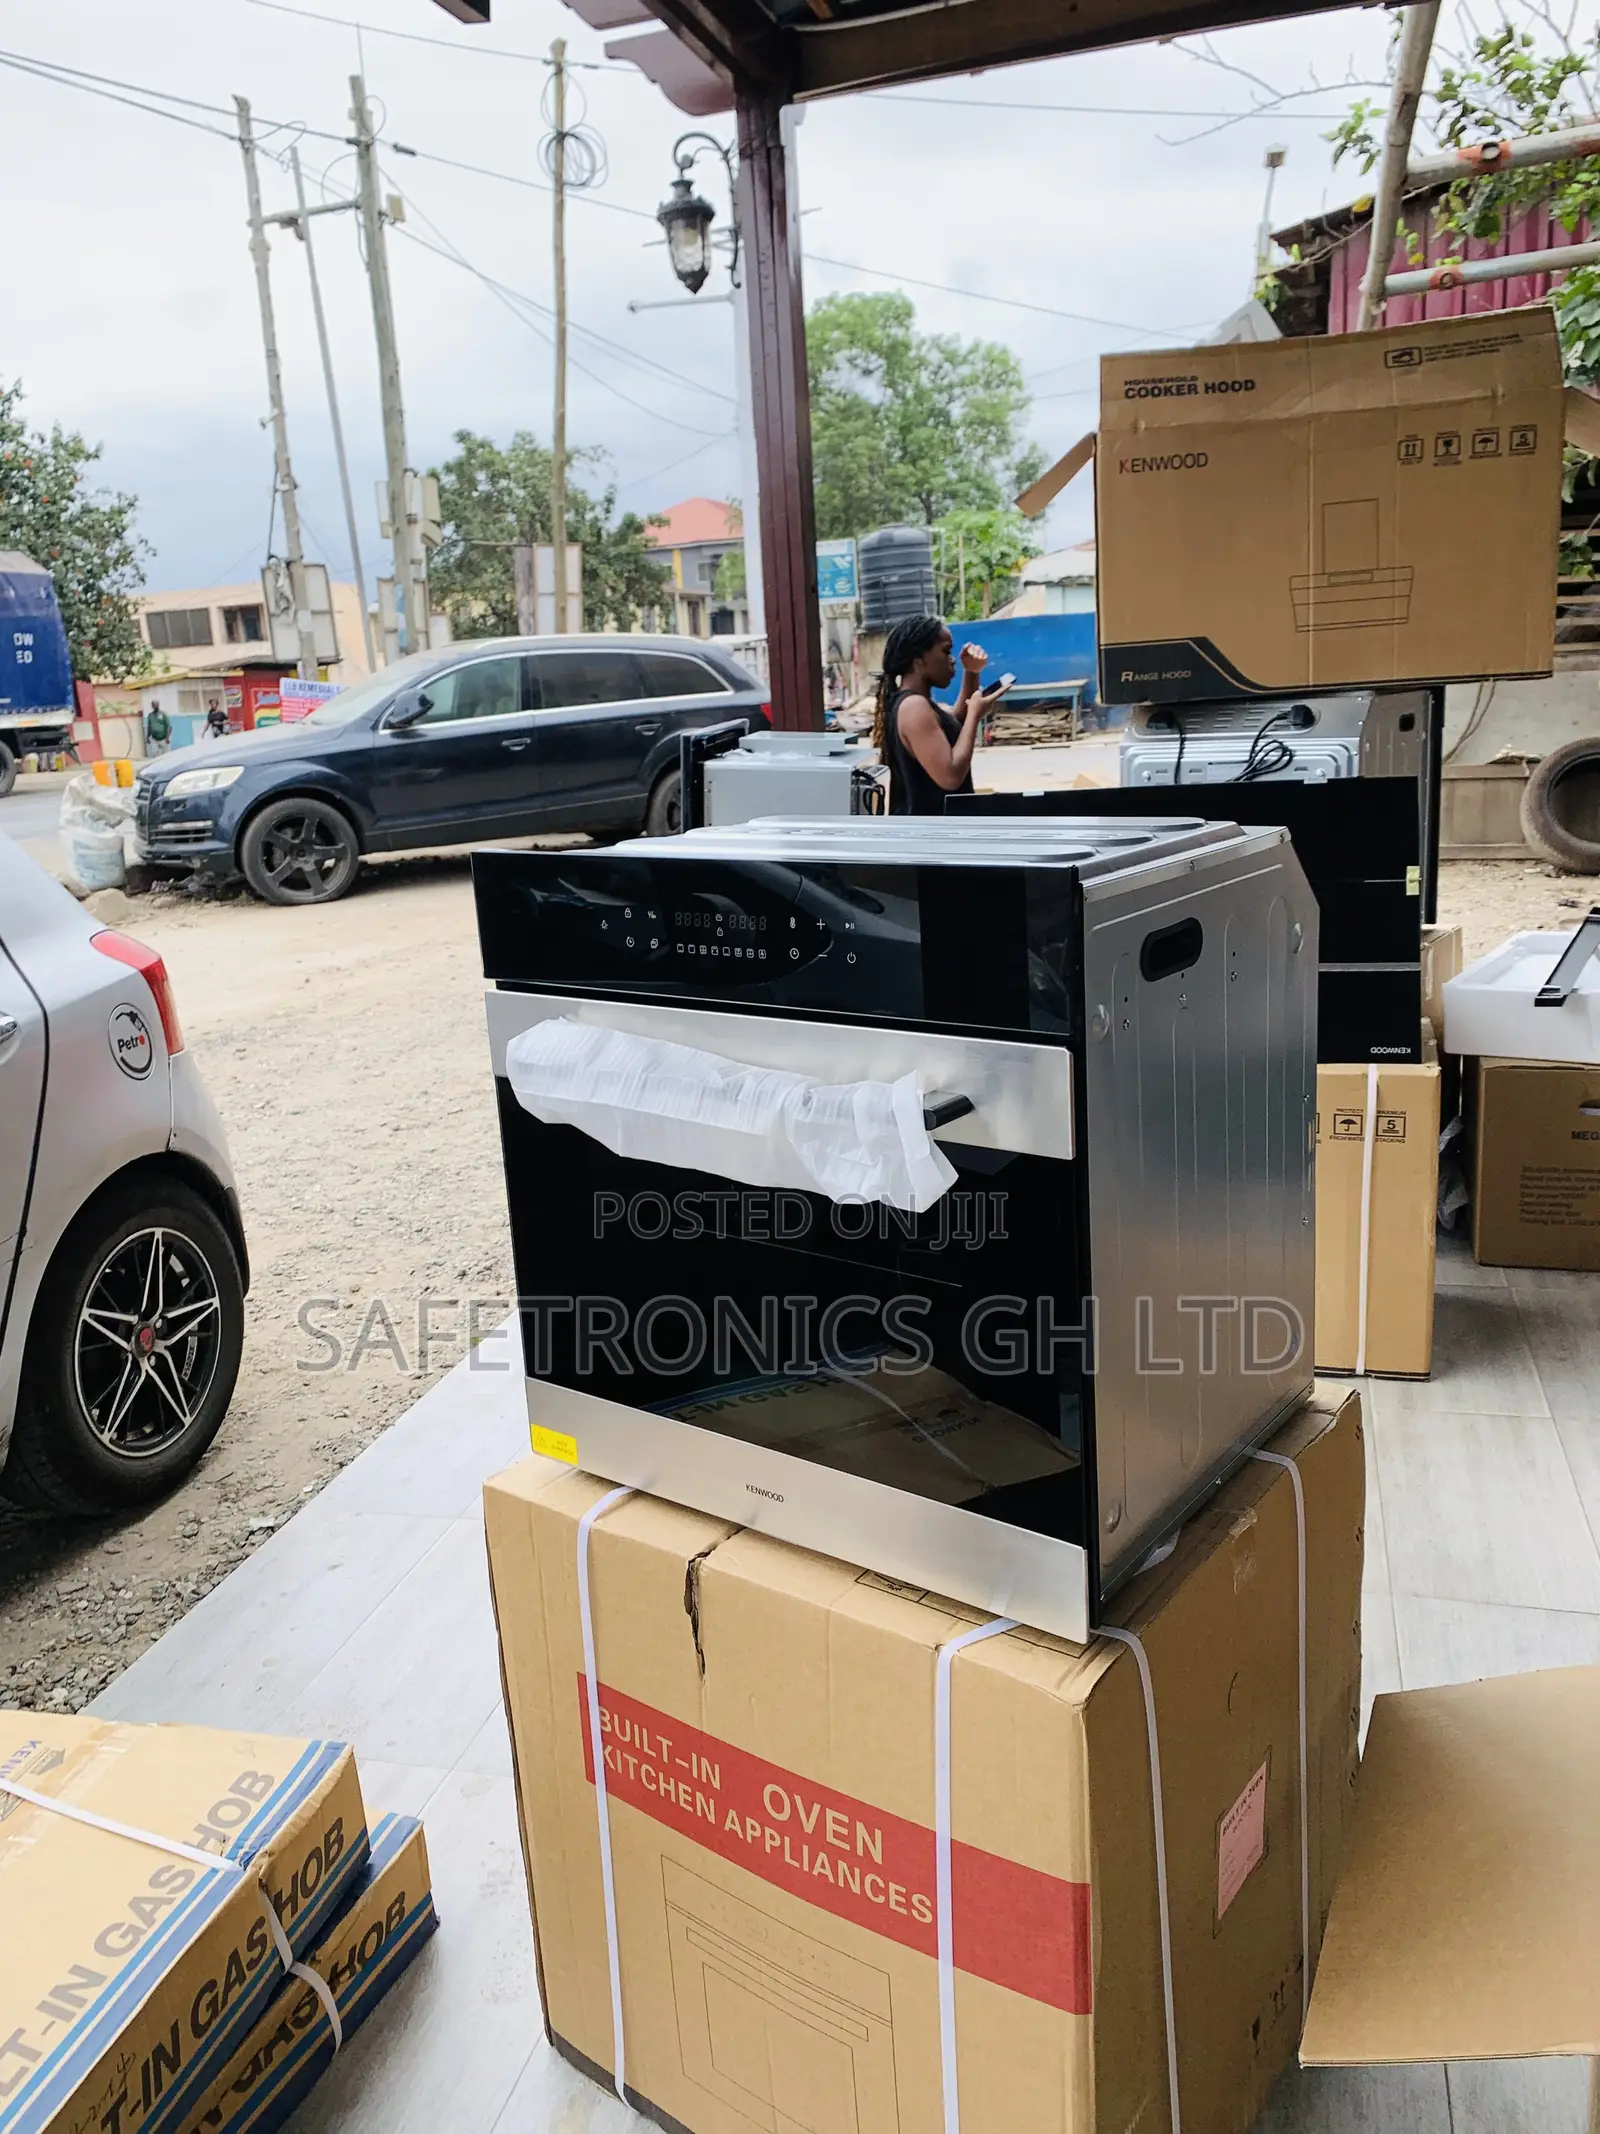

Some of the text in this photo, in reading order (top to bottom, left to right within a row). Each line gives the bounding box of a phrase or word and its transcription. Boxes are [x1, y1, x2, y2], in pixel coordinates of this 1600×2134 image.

[1124, 376, 1198, 386] HOUSEHOLD
[1124, 379, 1256, 399] COOKER HOOD
[1119, 452, 1209, 474] KENWOOD
[1370, 1046, 1411, 1054] KENWOOD
[1386, 1119, 1396, 1130] 5
[745, 1483, 785, 1503] KENWOOD
[599, 1705, 884, 1866] BUILT-IN OVEN
[93, 1864, 196, 1958] GAS
[183, 1769, 275, 1853] HOB
[723, 1808, 933, 1925] APPLIANCES
[190, 1916, 268, 2040] GAS
[273, 1816, 345, 1924] HOB
